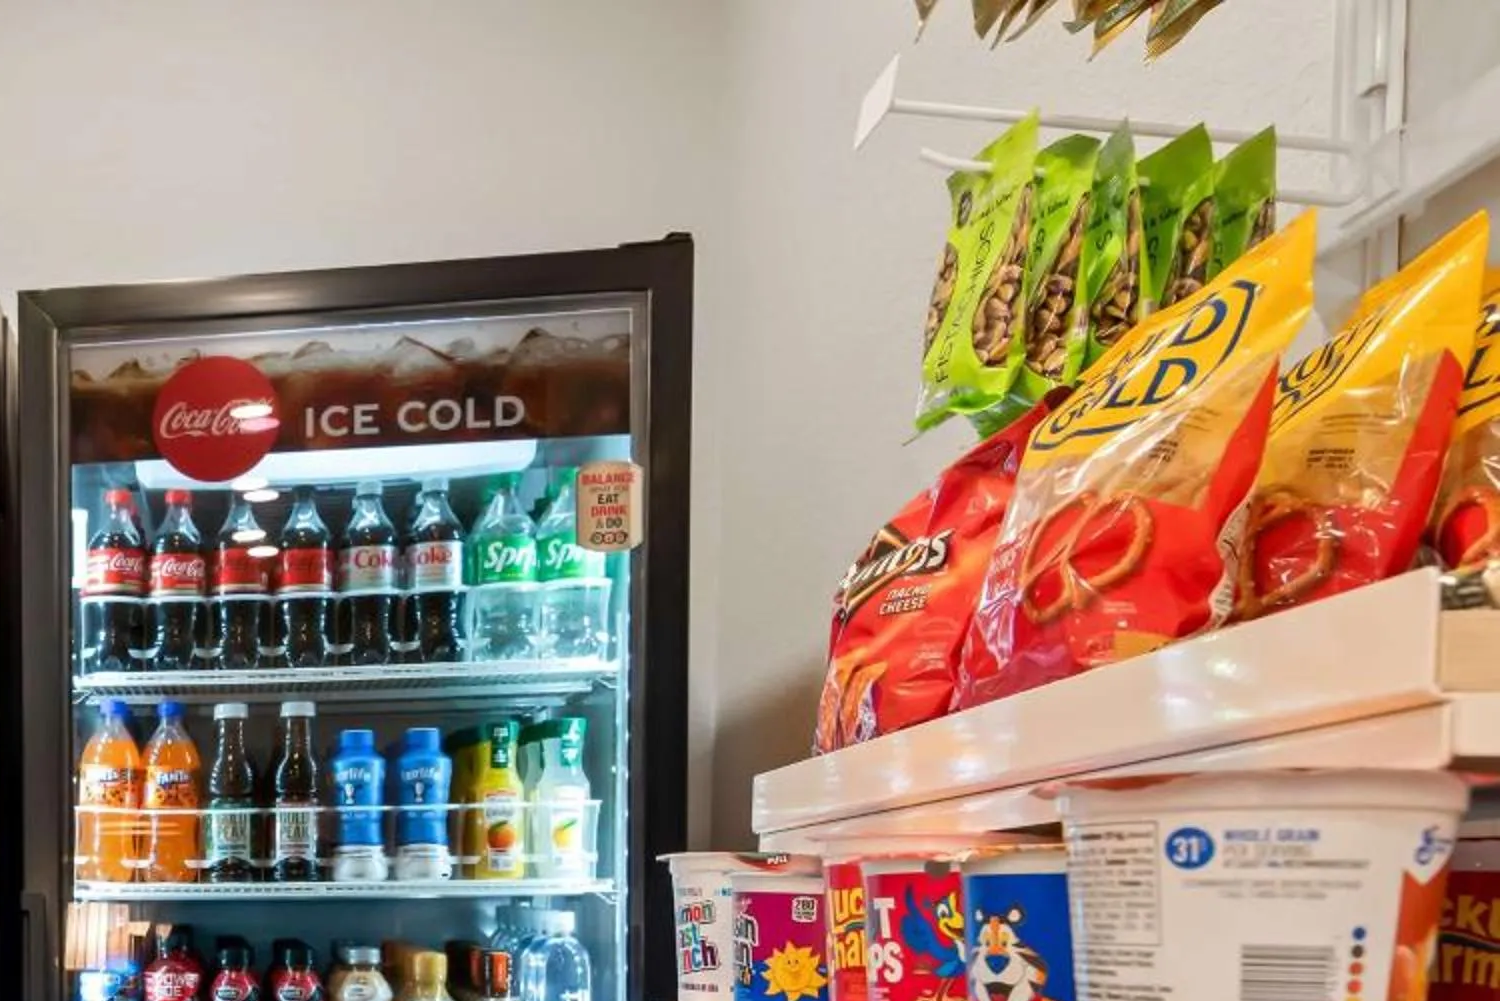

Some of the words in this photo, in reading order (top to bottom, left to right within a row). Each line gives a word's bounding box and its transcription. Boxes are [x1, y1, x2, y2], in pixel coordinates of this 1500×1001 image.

[304, 403, 380, 438] ICE
[396, 395, 526, 433] COLD
[598, 493, 619, 505] EAT
[591, 505, 627, 517] DRINK
[606, 517, 622, 529] DO
[879, 600, 927, 615] CHEESE
